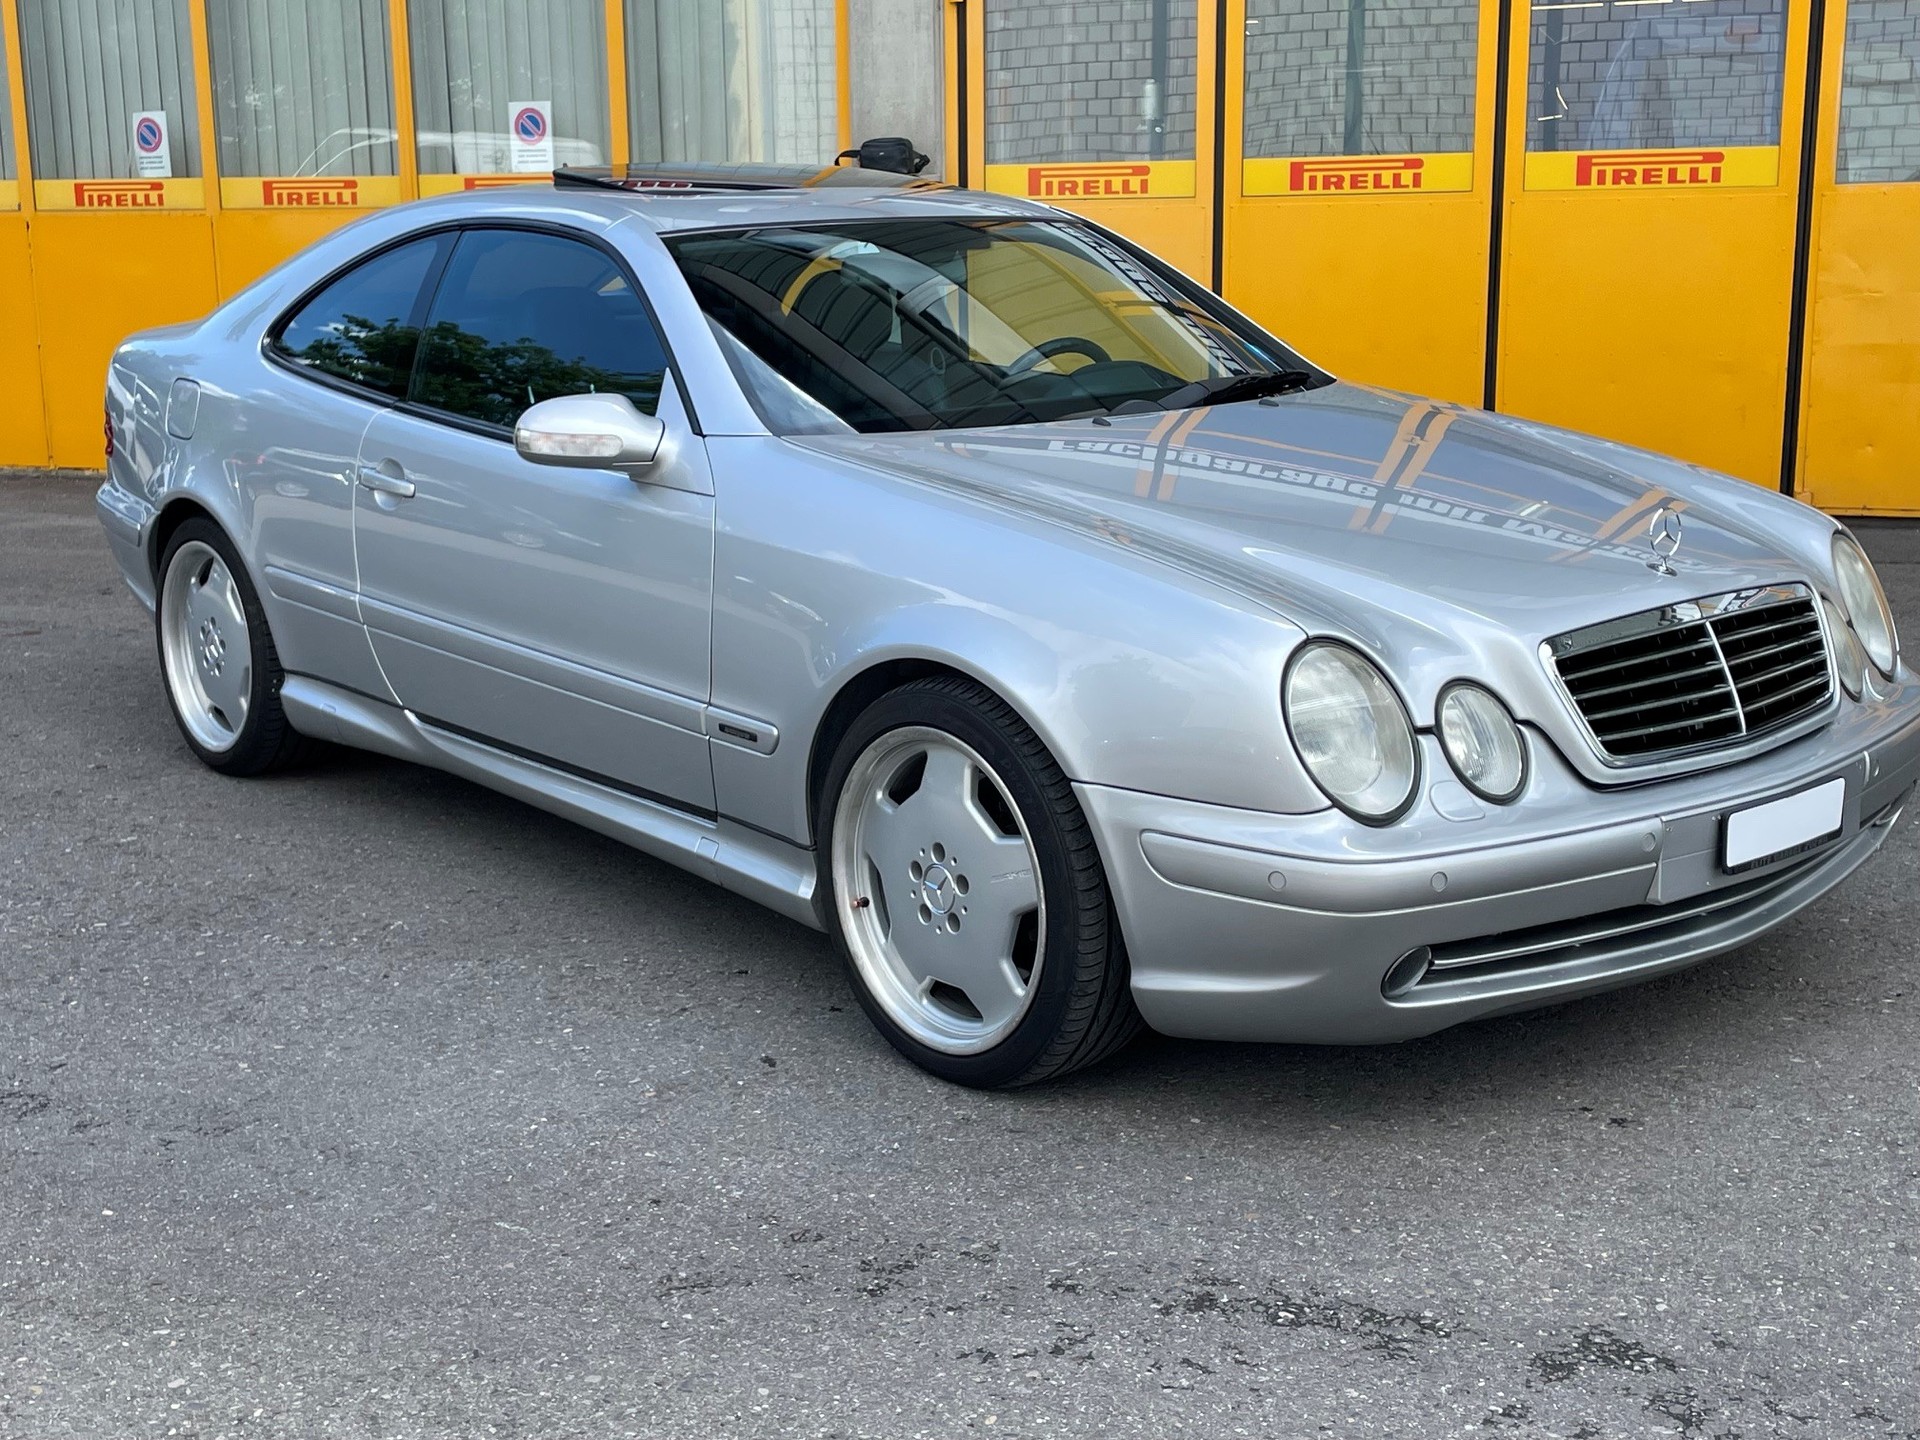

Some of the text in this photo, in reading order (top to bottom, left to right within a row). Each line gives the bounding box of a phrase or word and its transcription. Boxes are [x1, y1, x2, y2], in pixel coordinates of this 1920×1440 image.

[1028, 165, 1150, 196] PIRELLI
[1290, 158, 1424, 191] PIRELLI
[1576, 152, 1725, 186] PIRELLI
[74, 182, 164, 207] PIRELLI
[263, 180, 358, 205] PIRELLI
